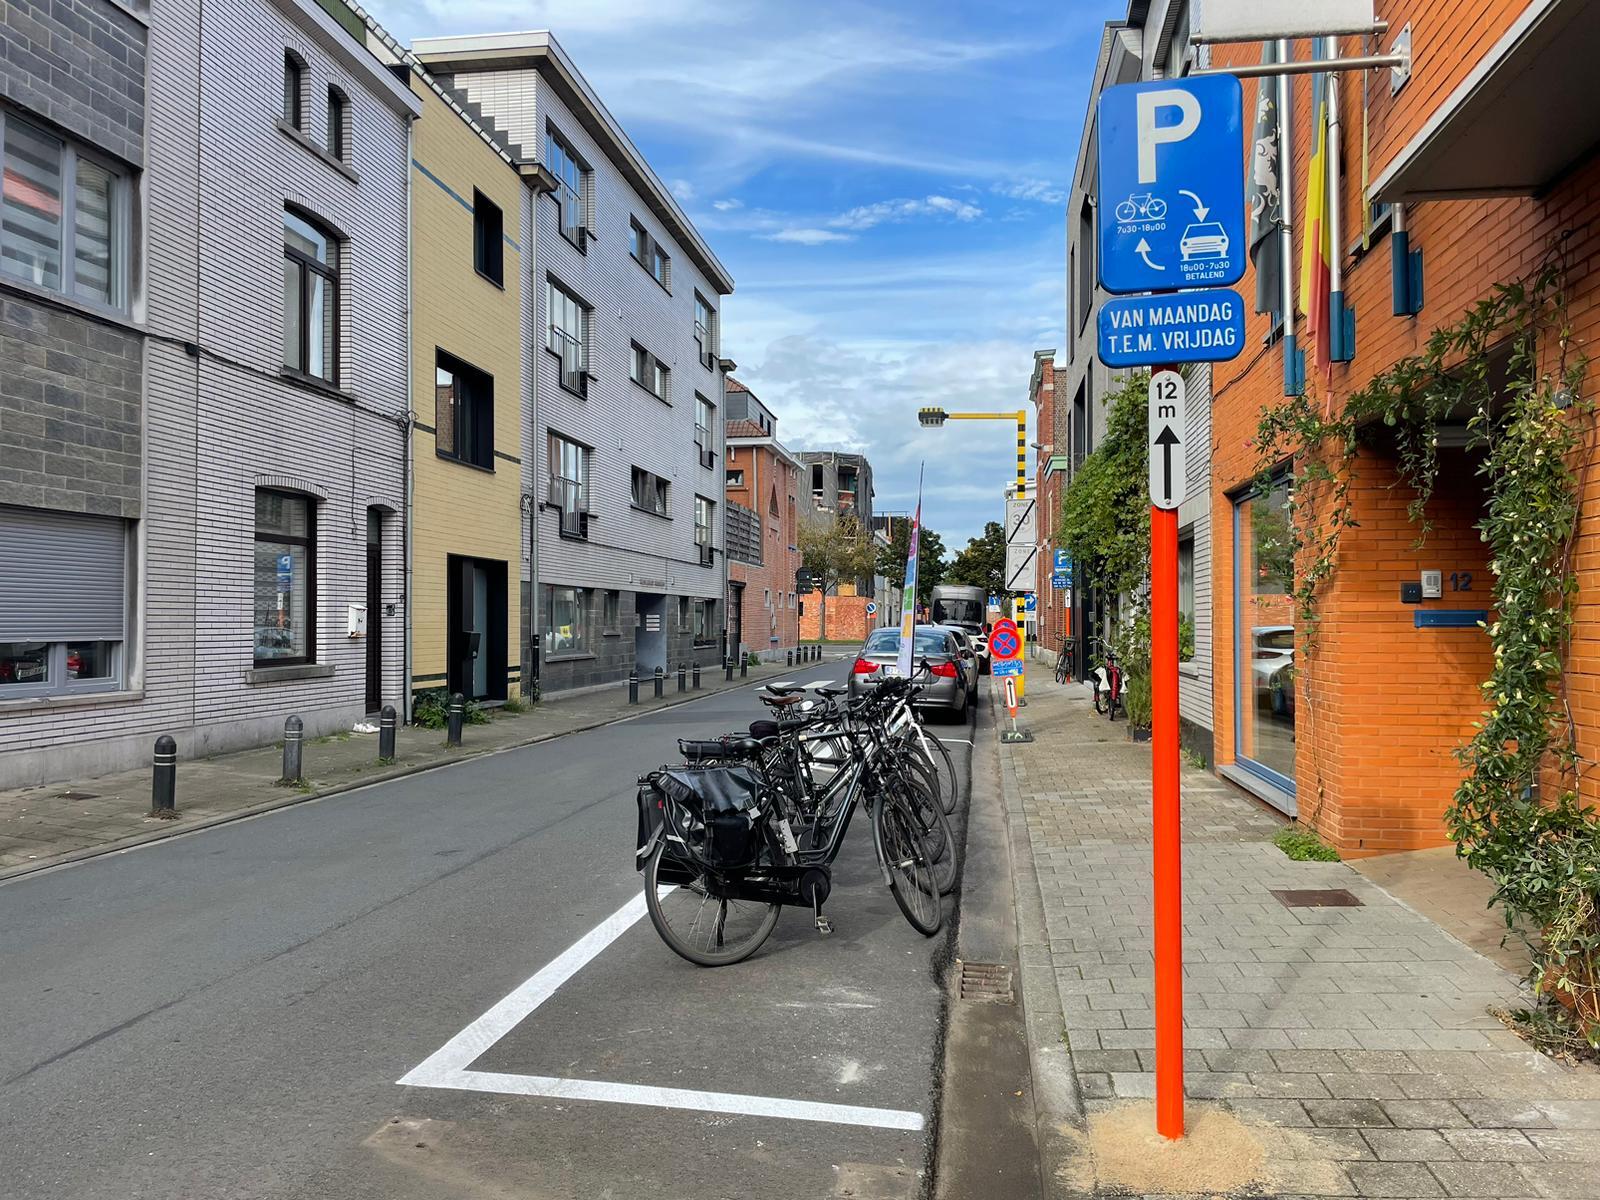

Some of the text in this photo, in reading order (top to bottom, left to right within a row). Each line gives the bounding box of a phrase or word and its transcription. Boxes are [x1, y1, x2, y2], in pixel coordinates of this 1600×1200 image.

[1137, 89, 1202, 184] P
[1185, 270, 1225, 281] BETALEND
[1110, 302, 1232, 329] VAN MAANDAG
[1108, 327, 1236, 354] T.E.M. VRIJDAG
[1156, 381, 1178, 400] 12
[1158, 405, 1176, 418] m
[1013, 513, 1030, 525] 30
[1450, 571, 1473, 592] 12
